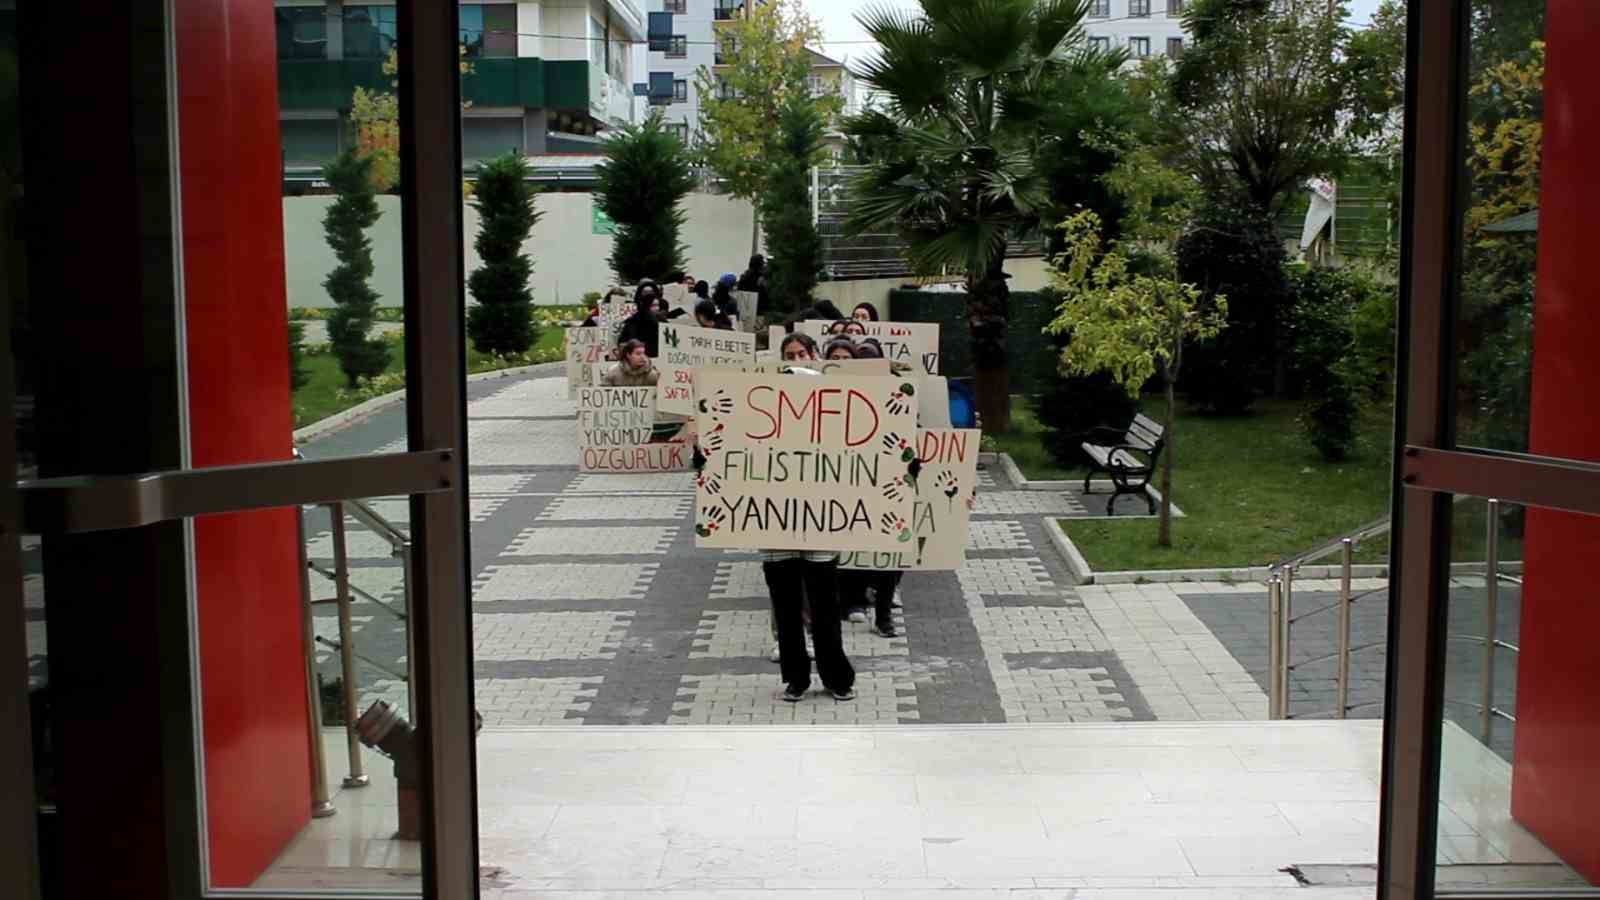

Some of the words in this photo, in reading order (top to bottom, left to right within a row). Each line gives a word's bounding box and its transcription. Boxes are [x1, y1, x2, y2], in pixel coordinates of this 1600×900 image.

[714, 339, 752, 355] ELBETTE
[581, 388, 649, 409] ROTAMIZ
[723, 446, 879, 488] FİLİSTİN'İN
[720, 494, 872, 534] YANINDA
